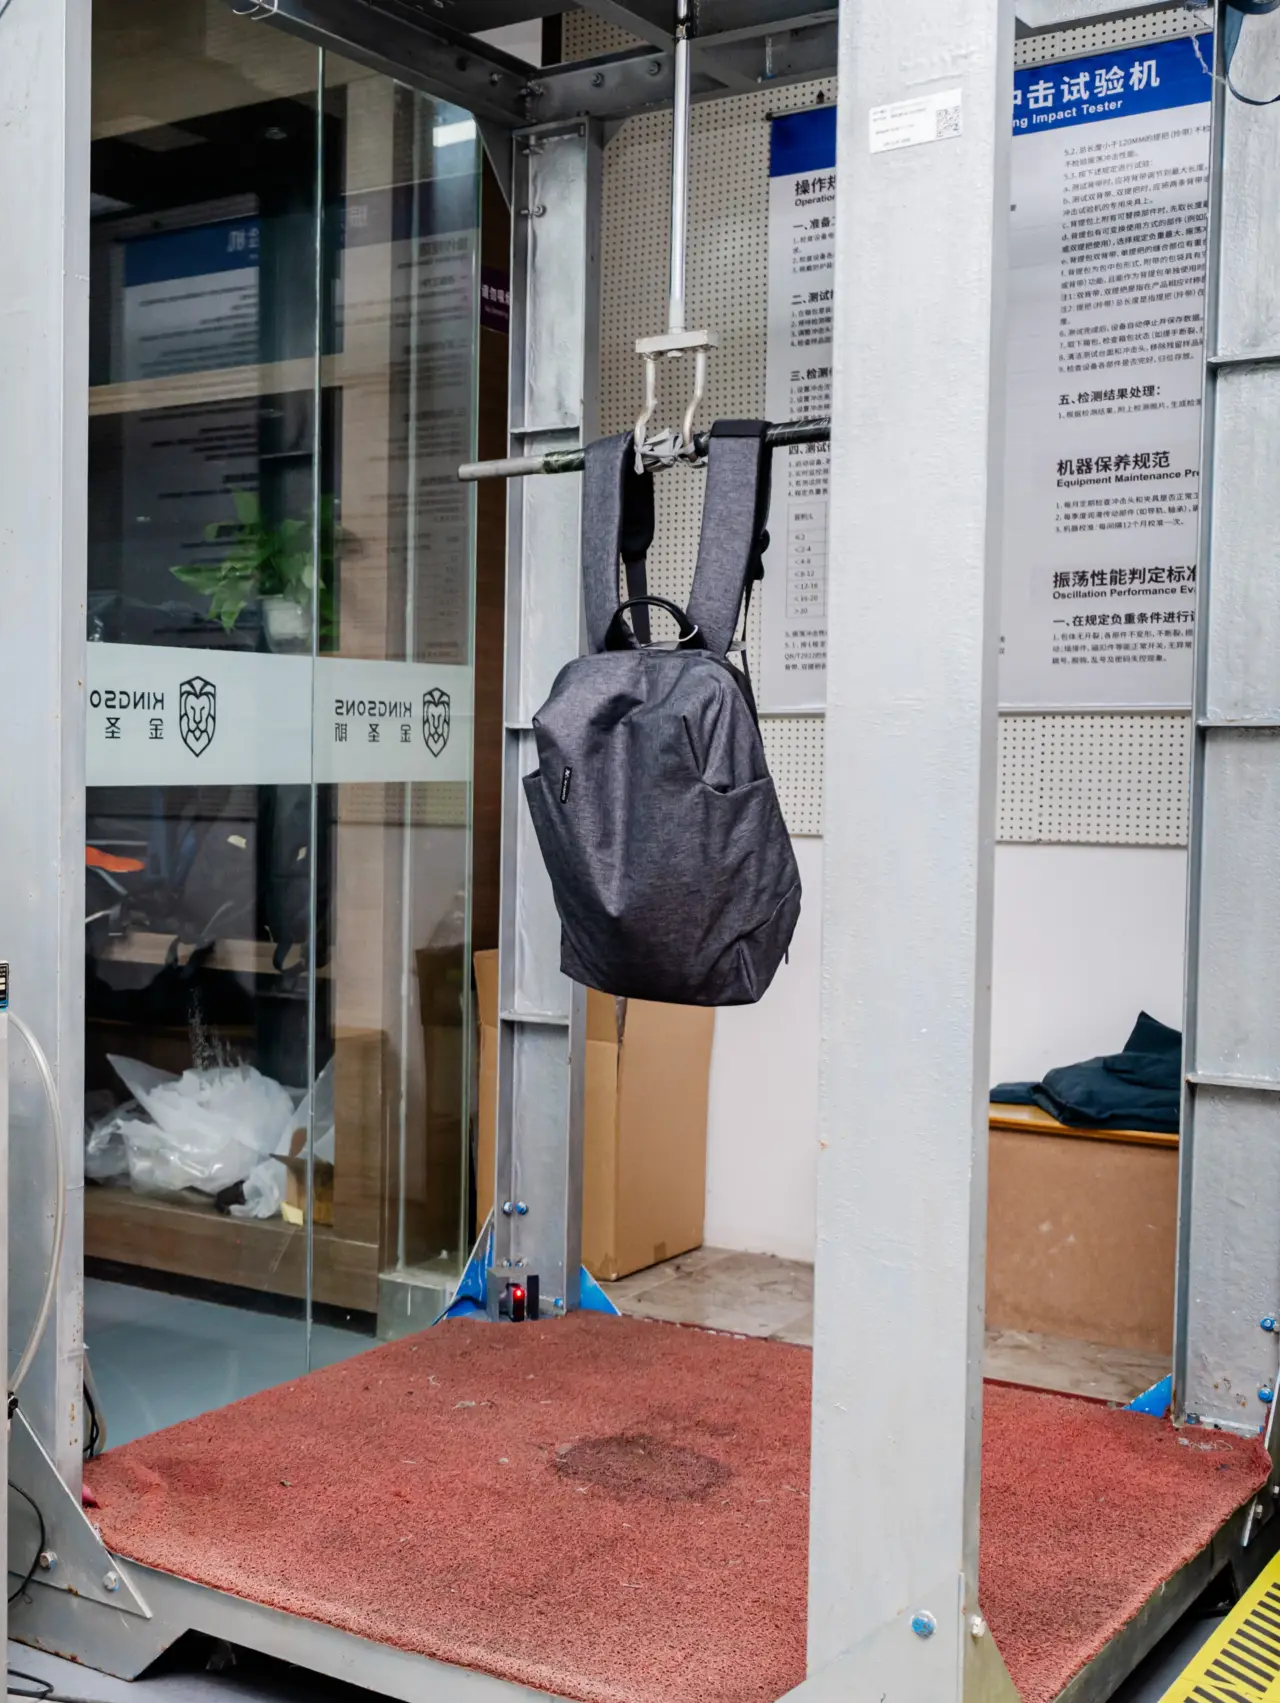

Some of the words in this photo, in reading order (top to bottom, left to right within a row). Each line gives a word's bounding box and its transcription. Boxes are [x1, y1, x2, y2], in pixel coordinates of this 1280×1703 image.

[1032, 107, 1077, 123] Impact
[1082, 100, 1123, 115] Tester
[1056, 450, 1171, 476] 机器保养规范
[1056, 475, 1112, 488] Equipment
[1115, 470, 1182, 484] Maintenance
[1053, 589, 1107, 600] Oscillation
[1110, 586, 1177, 598] Performance
